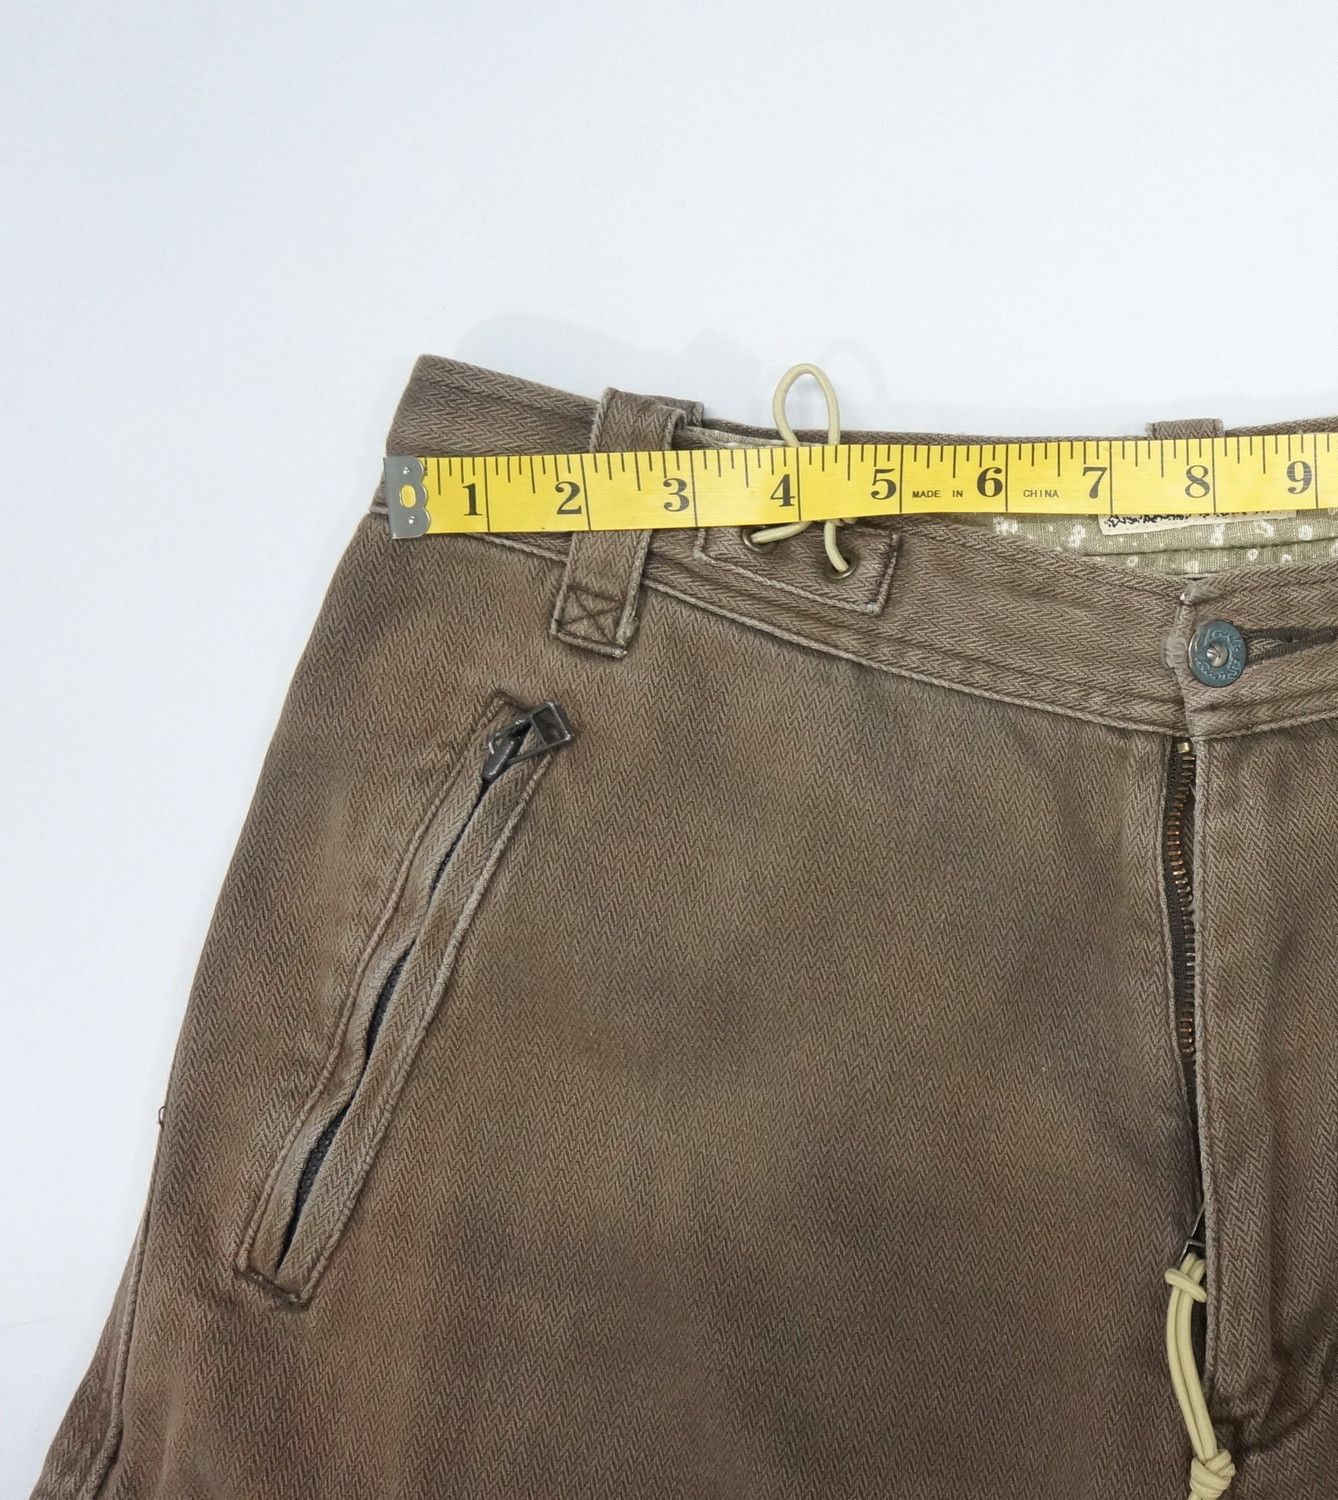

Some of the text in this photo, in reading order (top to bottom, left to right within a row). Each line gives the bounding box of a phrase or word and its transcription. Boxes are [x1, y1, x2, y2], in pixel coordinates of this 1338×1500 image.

[463, 484, 482, 516] 1
[555, 481, 582, 515] 2
[664, 479, 688, 512] 3
[770, 474, 795, 507] 4
[871, 468, 897, 500] 5
[976, 466, 1003, 497] 6
[1083, 466, 1107, 499] 7
[1185, 466, 1211, 499] 8
[1286, 460, 1313, 496] 9
[912, 489, 1059, 499] MADE IN CHINA
